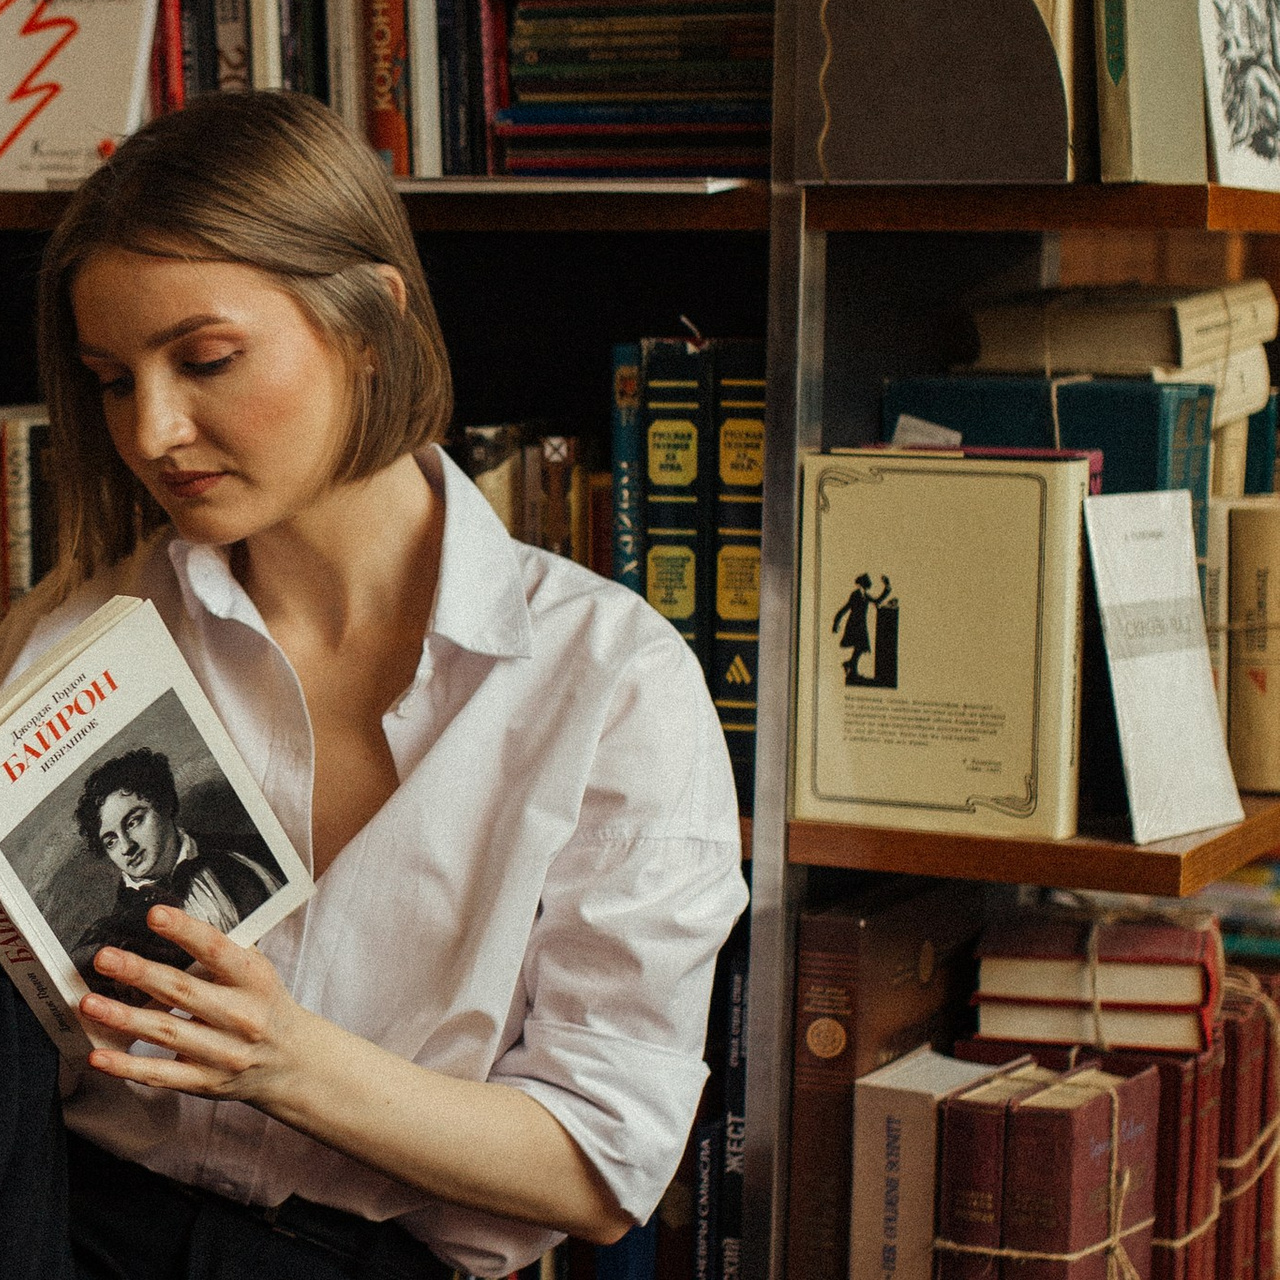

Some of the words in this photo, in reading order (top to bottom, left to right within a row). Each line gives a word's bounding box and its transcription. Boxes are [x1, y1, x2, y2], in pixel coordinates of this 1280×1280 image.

[0, 668, 120, 784] БАЙРОН
[10, 704, 52, 746] Джордж
[52, 673, 87, 704] Гордон
[40, 718, 99, 773] ИЗБРАННОЕ
[696, 1137, 712, 1217] СМЫСЛА
[724, 1111, 746, 1175] ЖЕСТ
